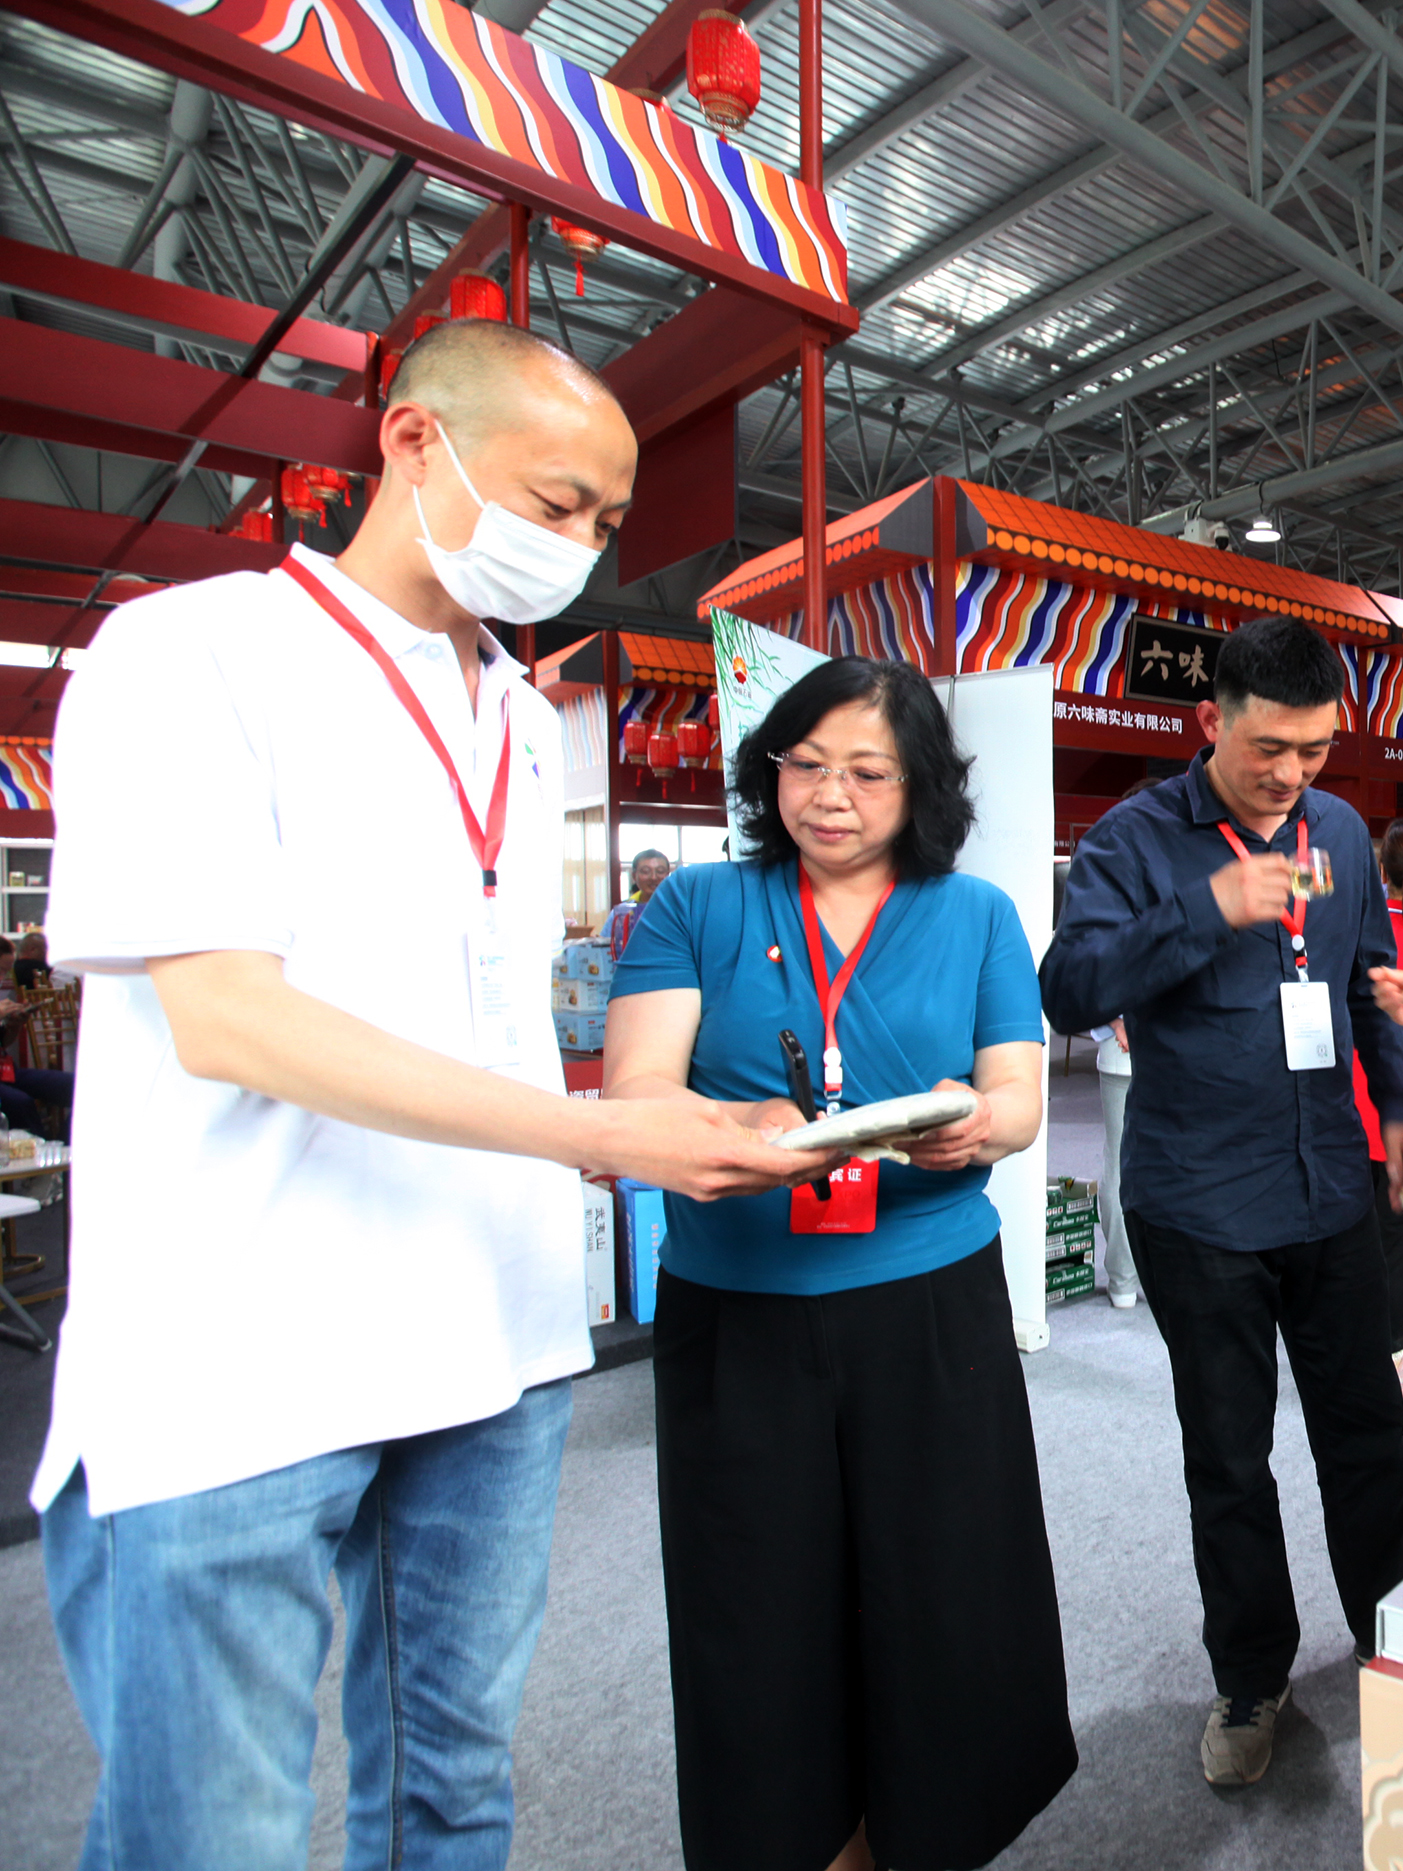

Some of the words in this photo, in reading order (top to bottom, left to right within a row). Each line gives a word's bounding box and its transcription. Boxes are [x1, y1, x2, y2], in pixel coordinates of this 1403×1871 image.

[1140, 640, 1209, 688] 六味
[1053, 702, 1183, 735] 原六味斋实业有限公司
[595, 1206, 606, 1251] 武夷山
